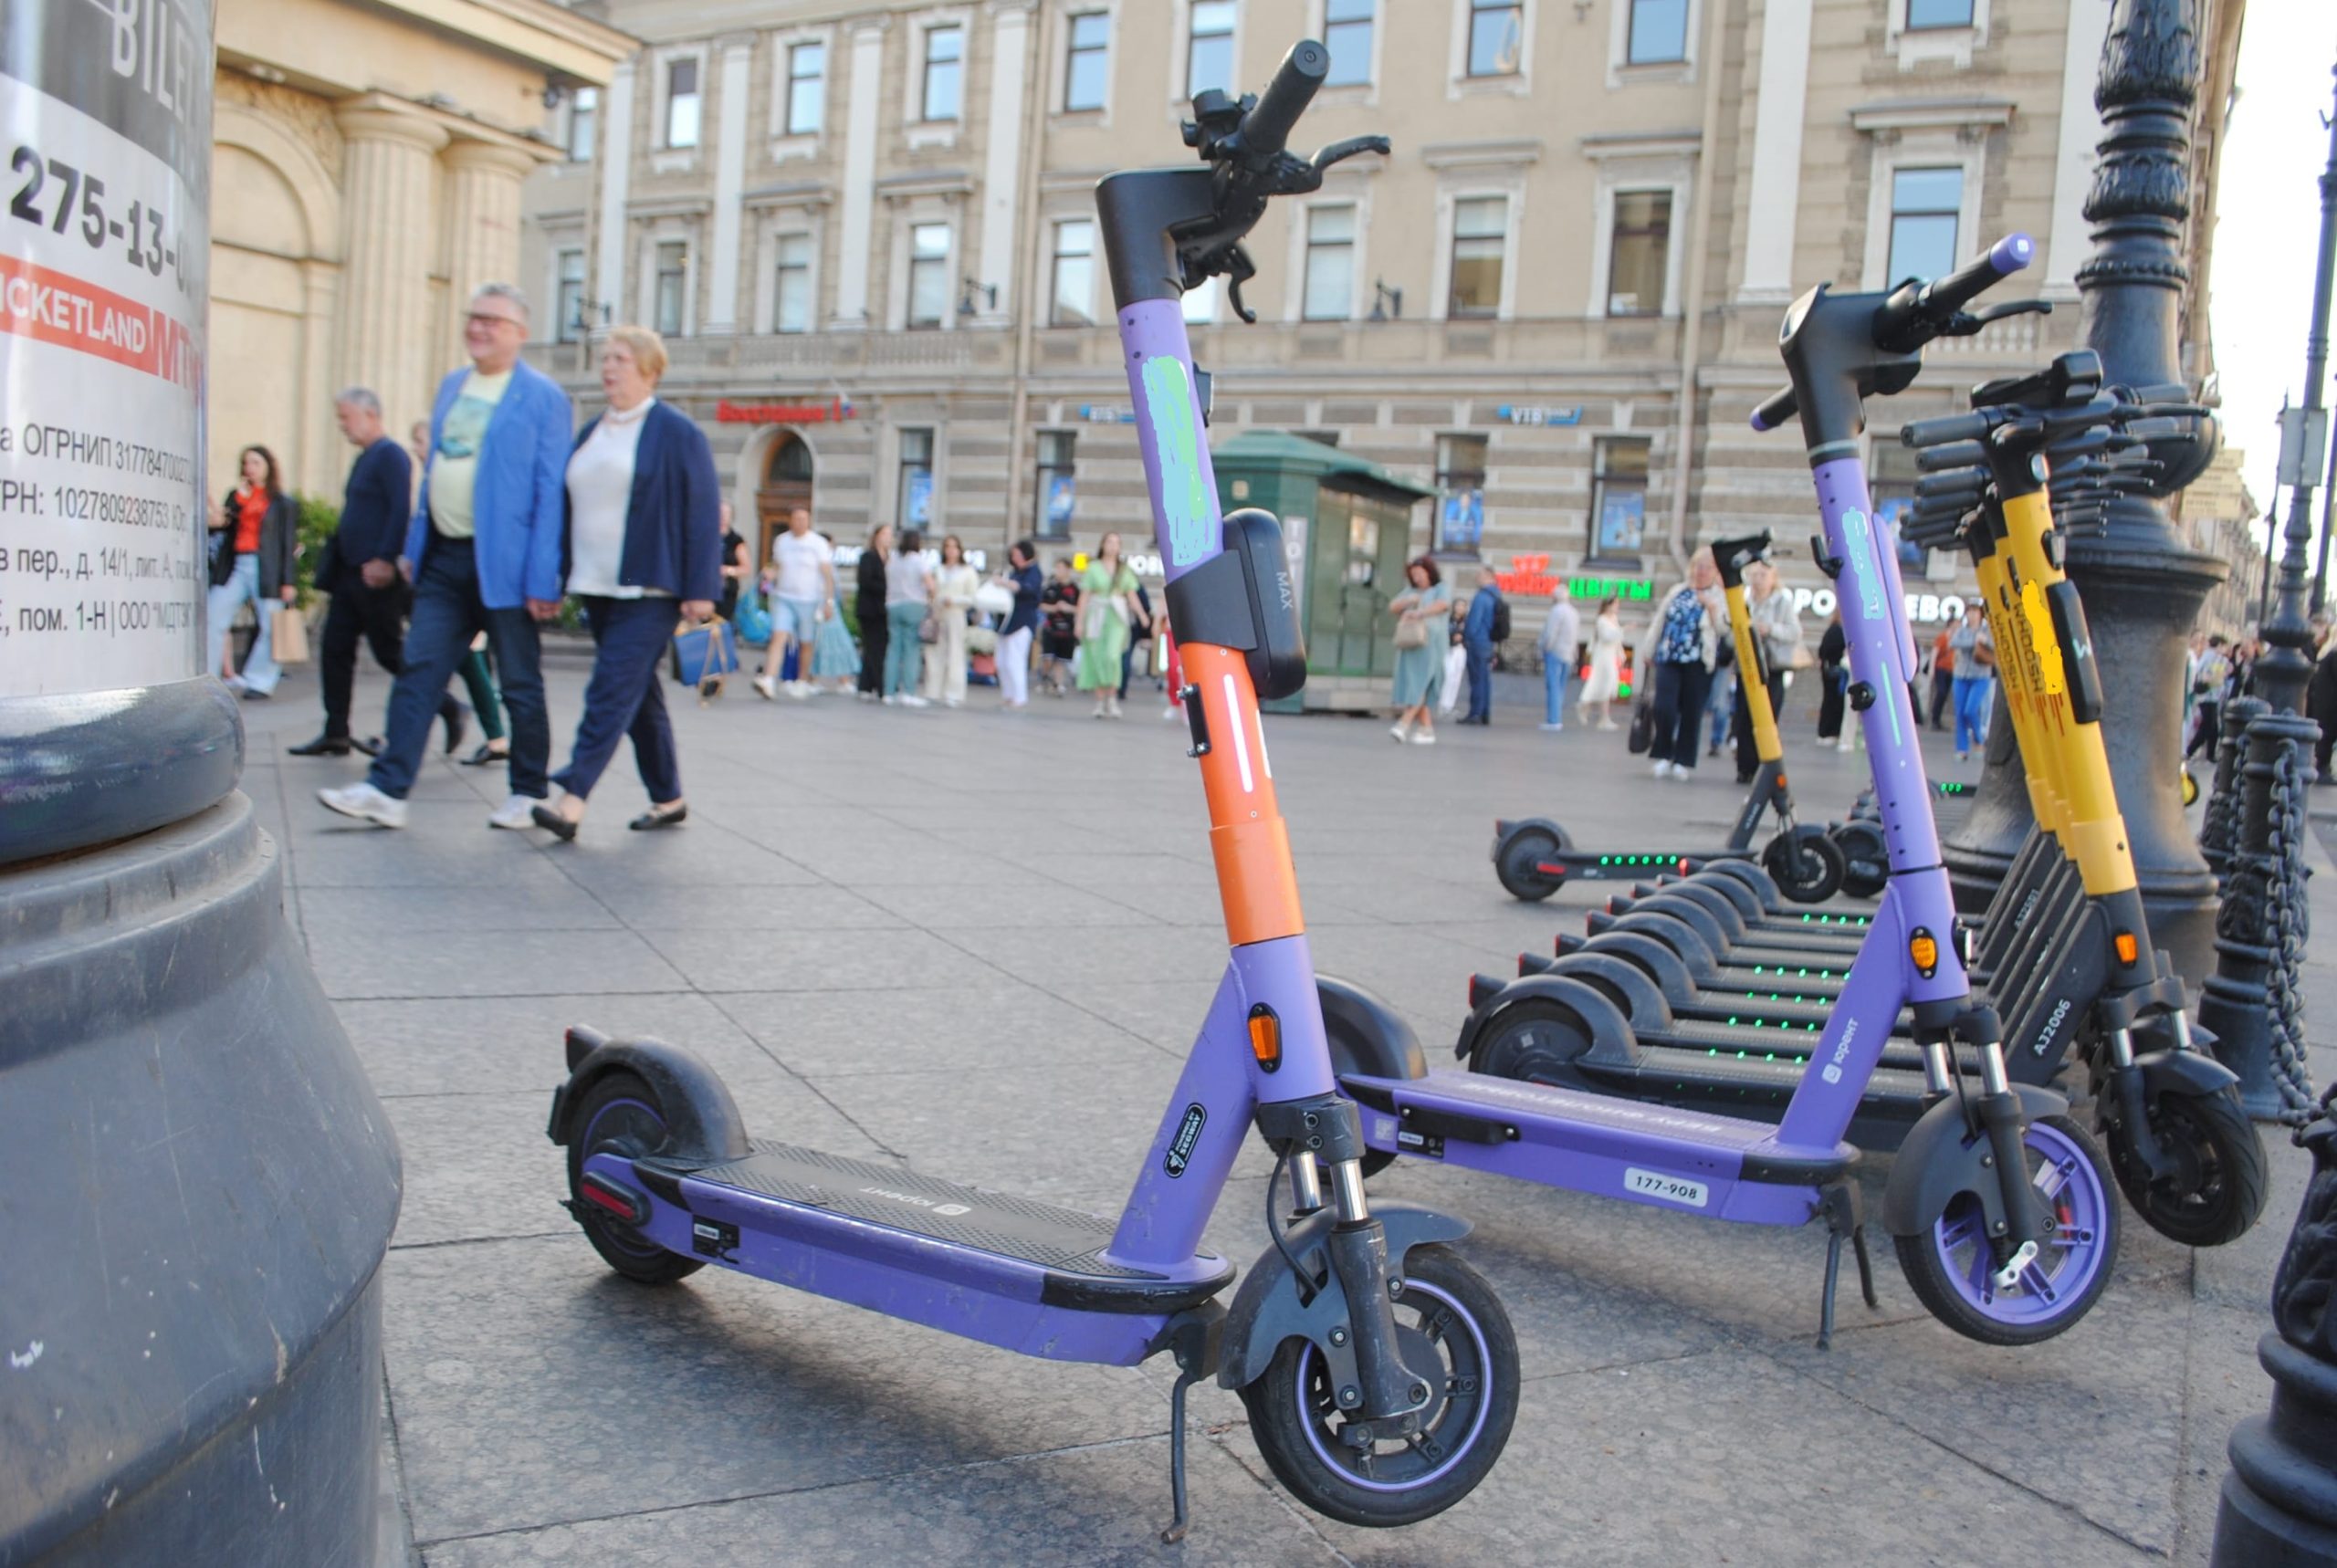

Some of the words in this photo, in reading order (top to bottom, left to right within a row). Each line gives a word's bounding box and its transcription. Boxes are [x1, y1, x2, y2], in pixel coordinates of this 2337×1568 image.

[23, 423, 111, 467] ОГРНИП
[0, 478, 44, 515] РН:
[1276, 571, 1294, 611] MAX
[20, 607, 68, 632] пом.
[2015, 602, 2044, 692] WHOOSH
[1832, 1017, 1859, 1064] юрент
[2033, 998, 2071, 1057] AJ2006
[1179, 1114, 1201, 1155] SEGWAY
[1636, 1175, 1698, 1199] 177-908
